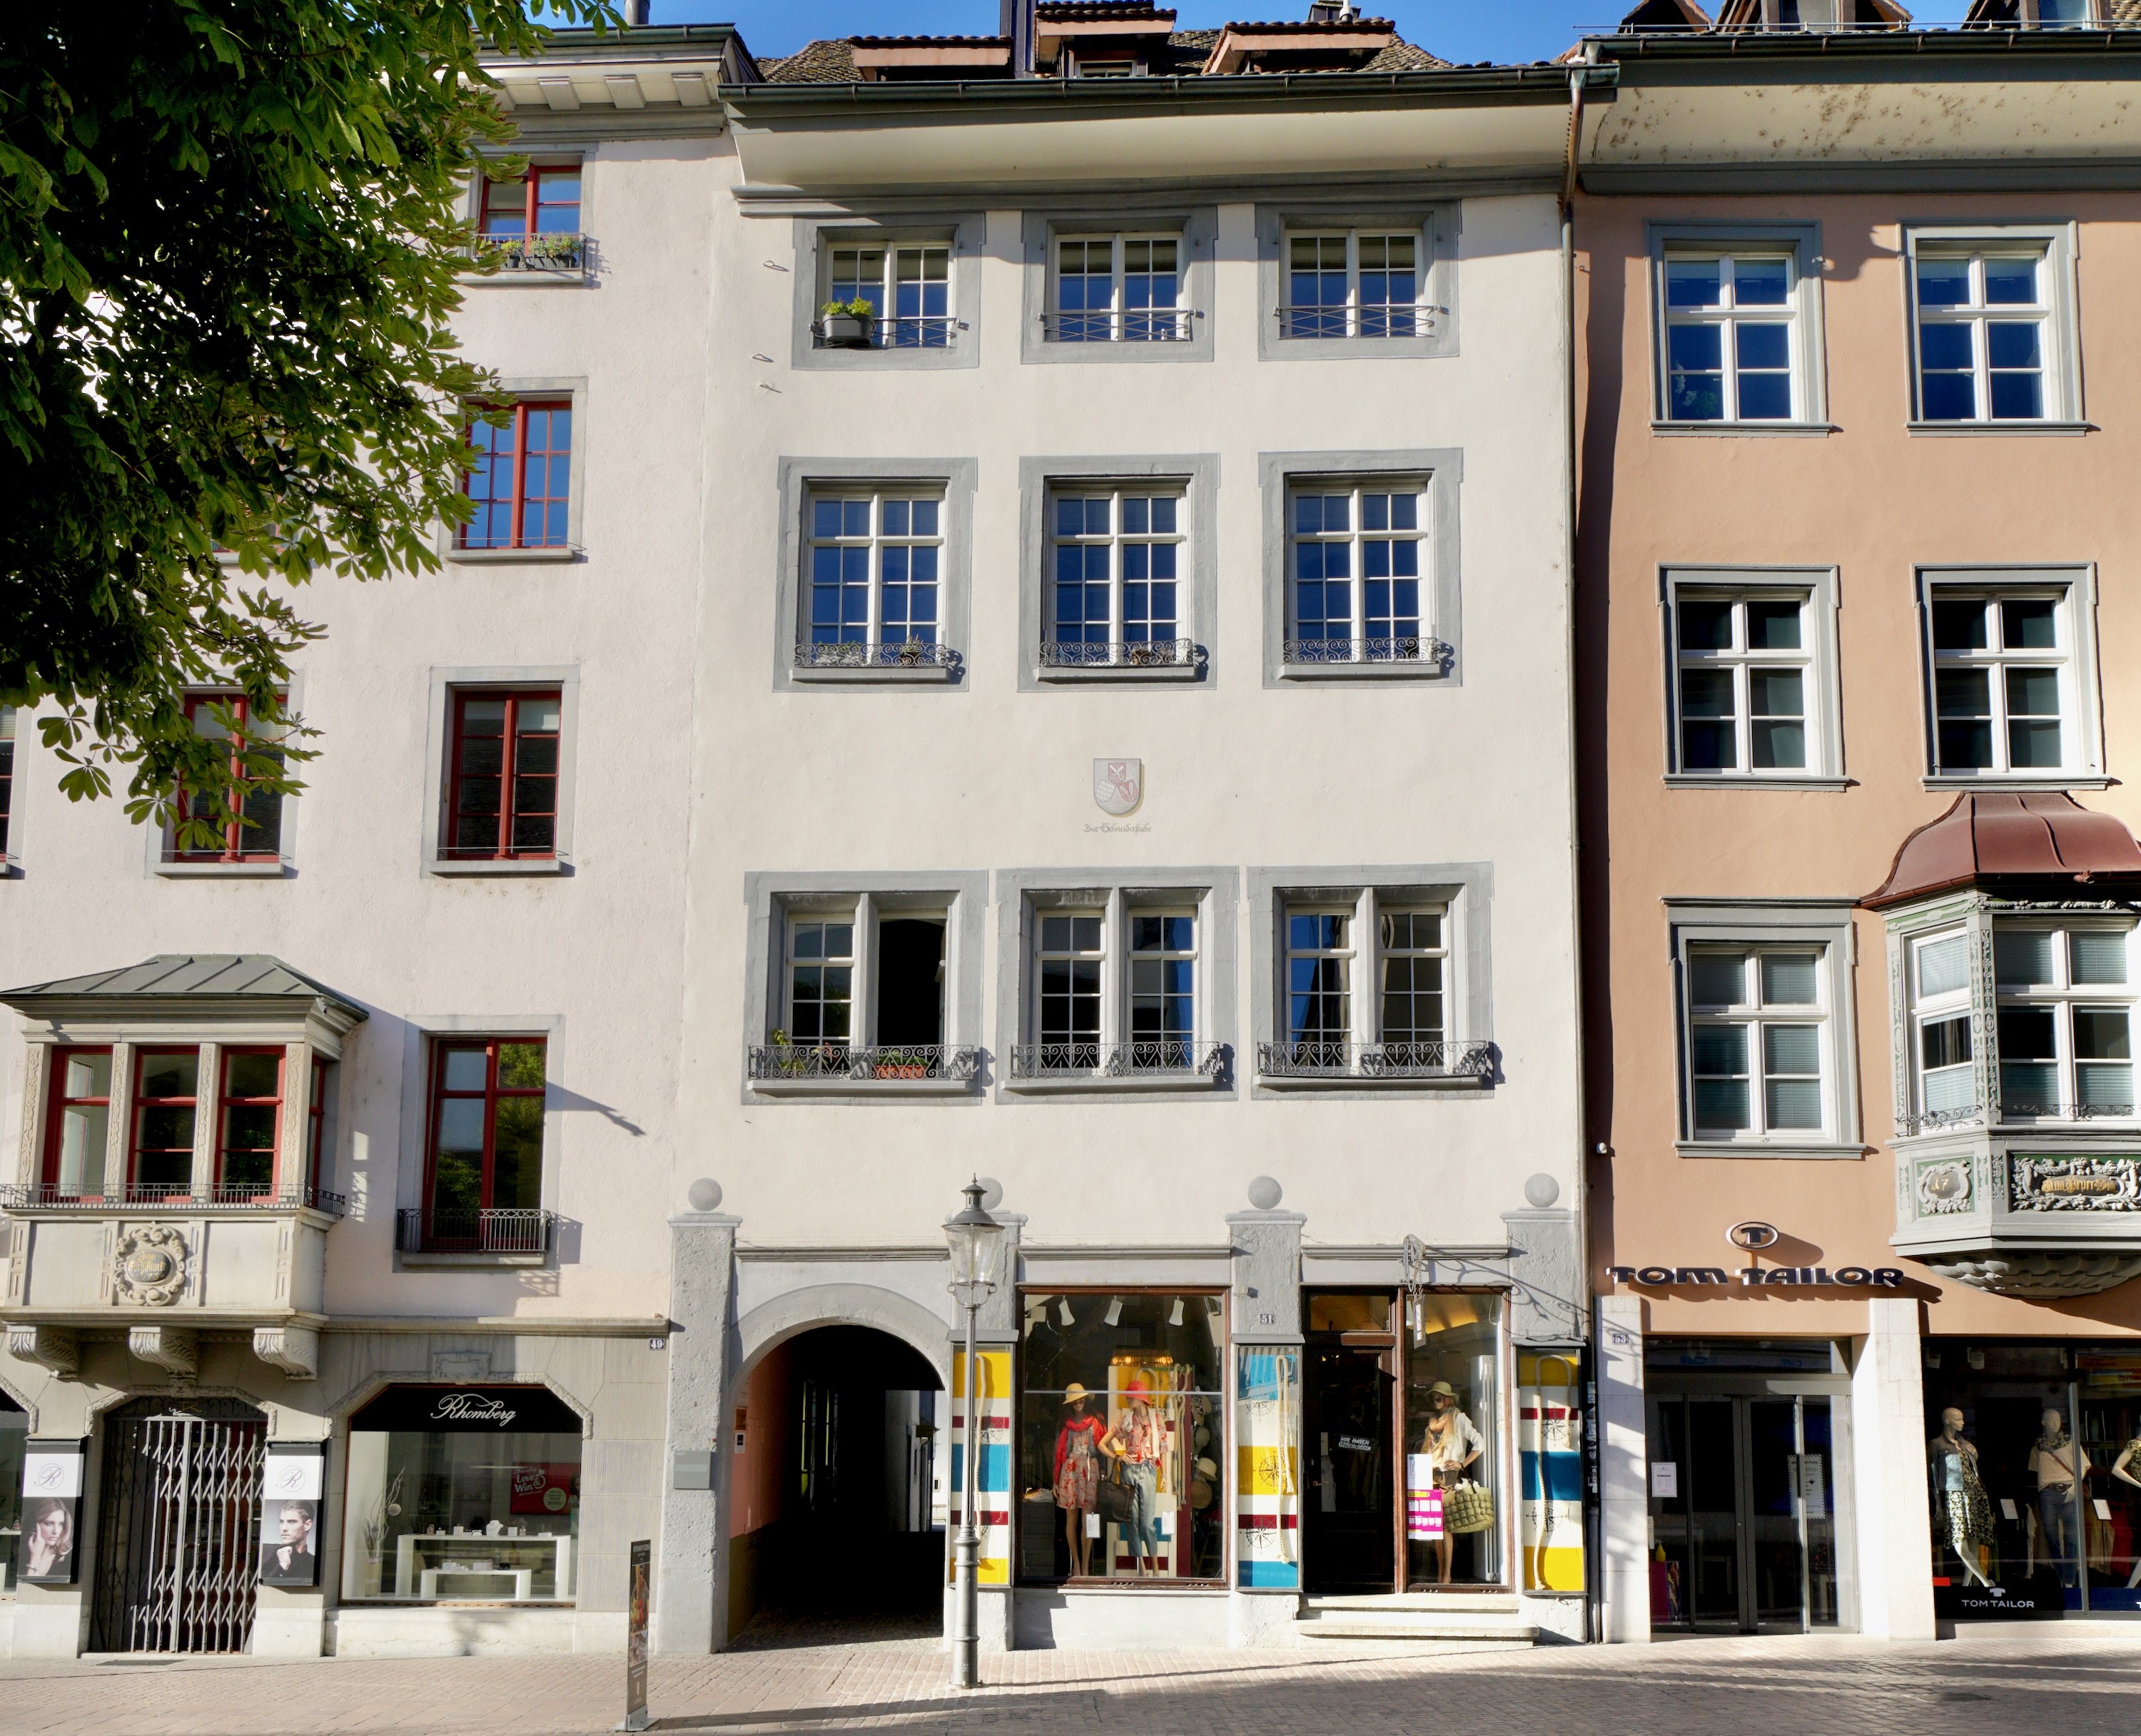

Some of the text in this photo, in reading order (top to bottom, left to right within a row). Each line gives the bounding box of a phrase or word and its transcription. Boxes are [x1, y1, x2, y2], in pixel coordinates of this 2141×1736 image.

[1084, 822, 1098, 833] Zur
[1606, 1266, 1905, 1288] TOM TAILOR
[1261, 1314, 1272, 1324] 51
[650, 1339, 663, 1349] 49
[430, 1394, 516, 1426] Rhomberg
[517, 1473, 535, 1483] Love
[514, 1483, 534, 1493] Win
